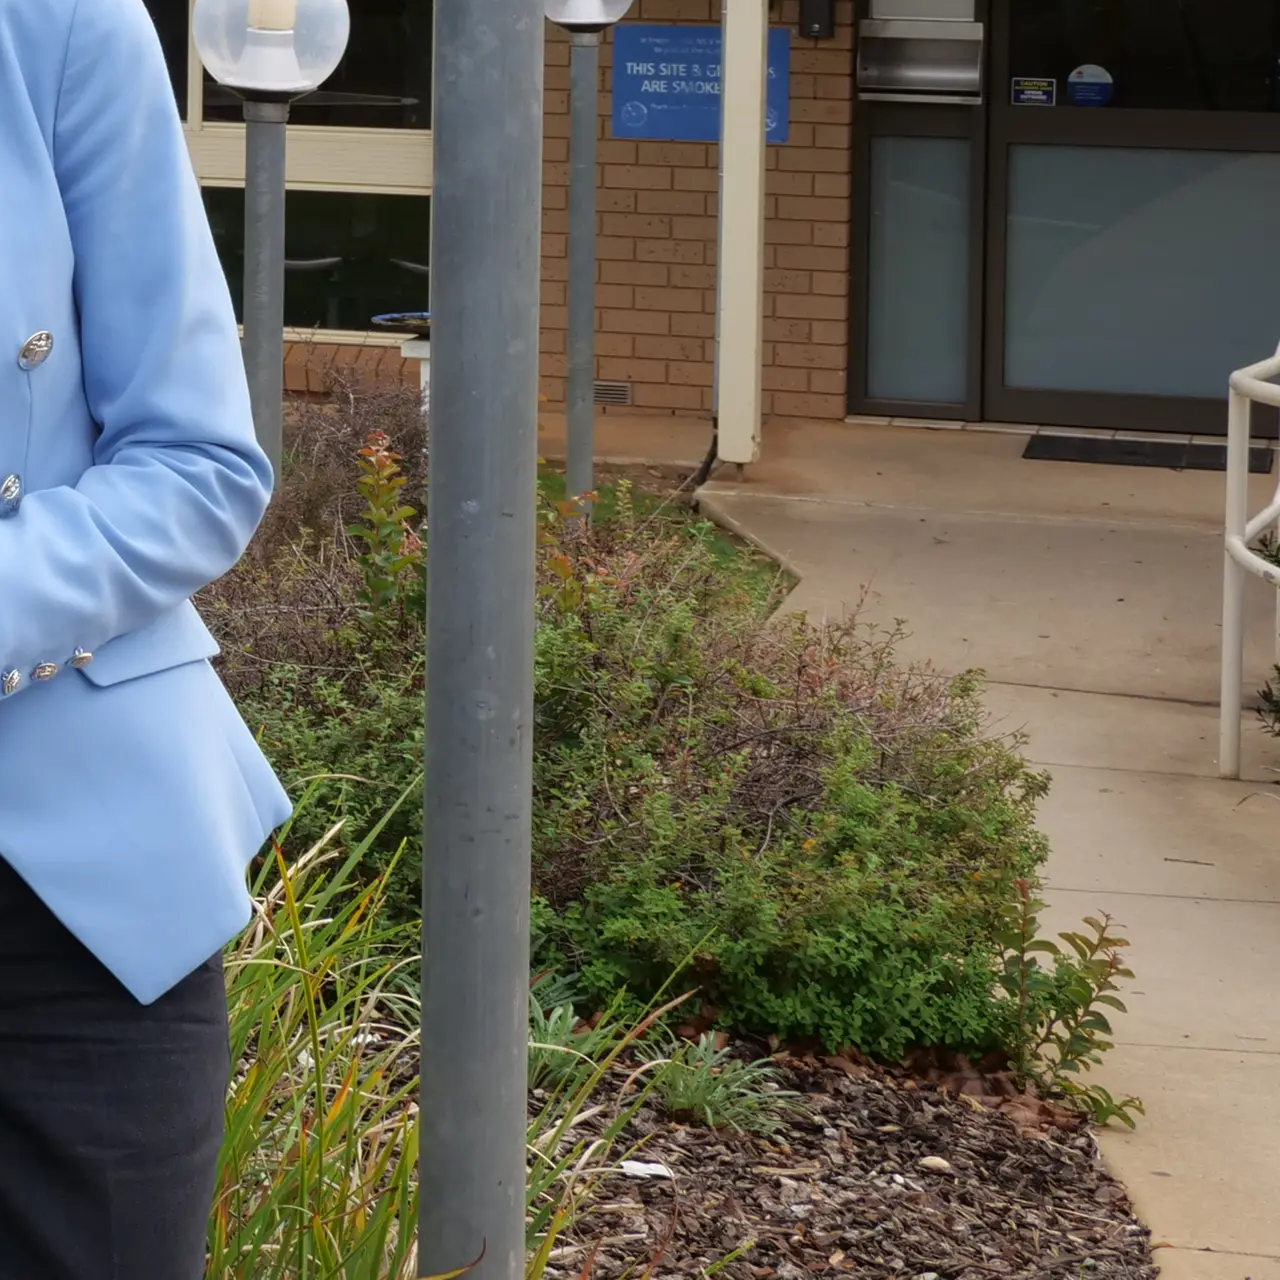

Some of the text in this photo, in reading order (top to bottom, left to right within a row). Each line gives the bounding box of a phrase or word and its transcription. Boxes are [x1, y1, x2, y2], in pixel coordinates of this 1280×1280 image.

[626, 62, 655, 75] THIS
[659, 63, 687, 76] SITE
[641, 81, 668, 92] ARE
